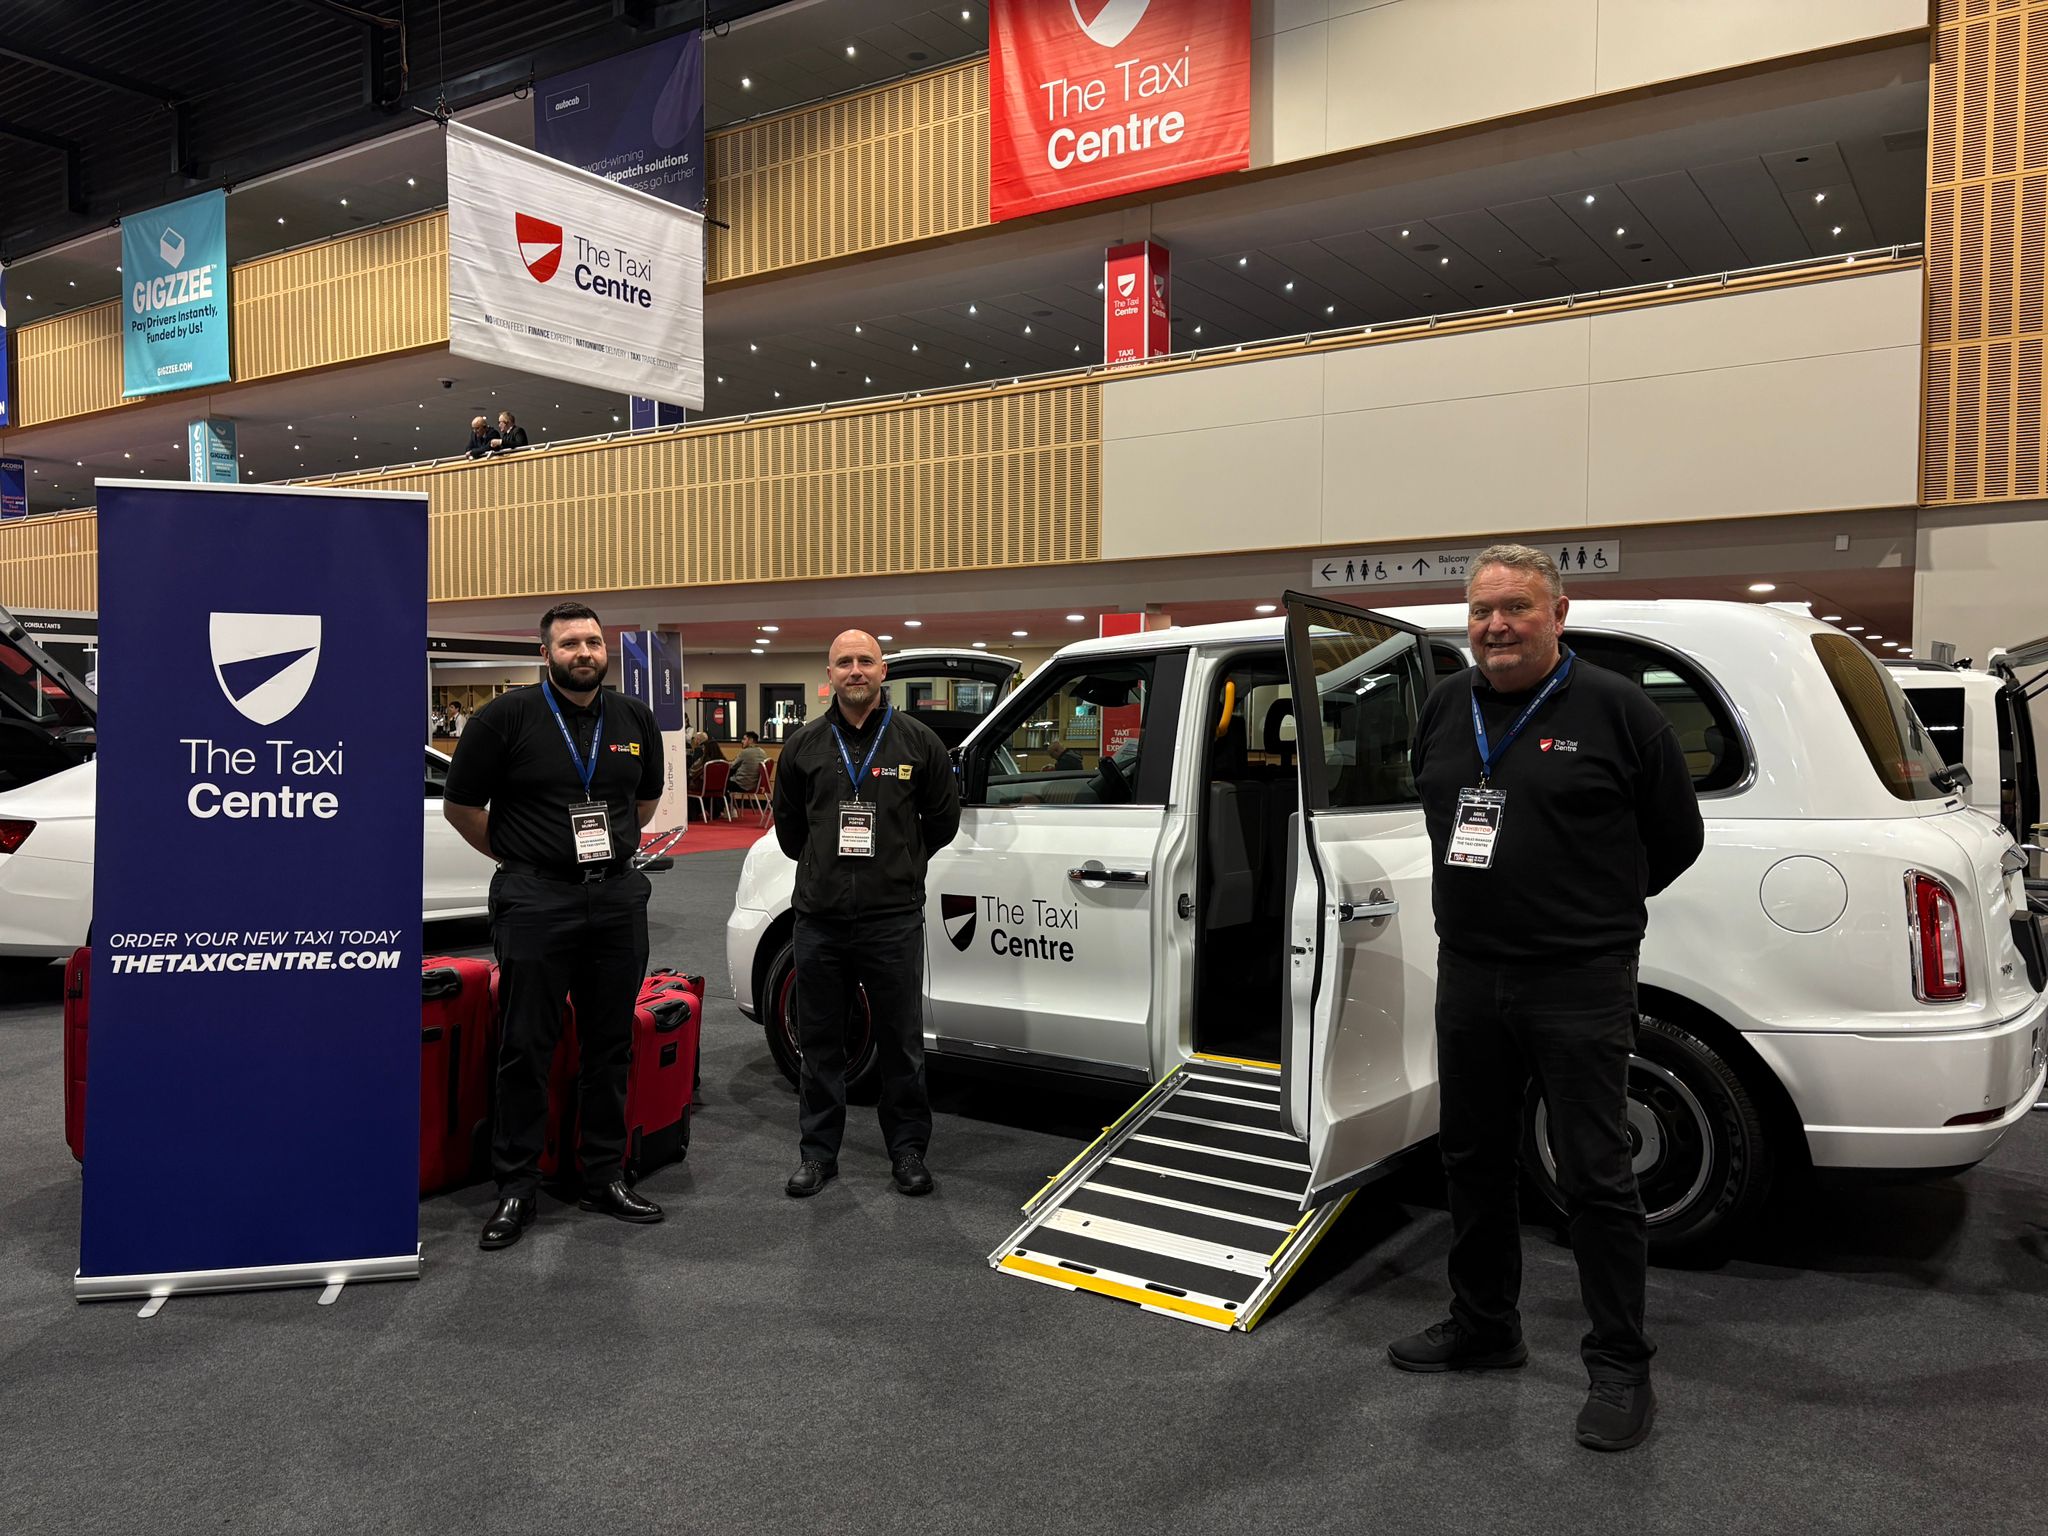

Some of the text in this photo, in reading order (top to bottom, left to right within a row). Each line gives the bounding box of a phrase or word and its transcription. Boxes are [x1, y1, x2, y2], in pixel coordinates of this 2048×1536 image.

[1039, 45, 1190, 121] The Taxi
[555, 95, 581, 111] autocab
[1047, 111, 1185, 170] Centre
[644, 153, 689, 174] solutions
[650, 175, 663, 190] go
[664, 167, 696, 184] further
[574, 235, 651, 282] The Taxi
[575, 264, 652, 308] Centre
[1114, 297, 1139, 308] The Taxi
[1114, 307, 1139, 317] Centre
[132, 304, 218, 332] Pay Drivers Instantly,
[146, 321, 203, 344] Funded by Us!
[485, 314, 493, 324] NO
[511, 321, 524, 333] FEES
[528, 325, 550, 339] FINANCE
[551, 331, 573, 344] EXPERTS
[575, 338, 605, 352] NATIONWIDE
[605, 345, 627, 358] DELIVERY
[630, 351, 640, 361] TAXI
[1118, 348, 1133, 357] TAXI
[157, 361, 193, 376] GIGZZEE.COM
[1, 462, 23, 470] ACORN
[1438, 555, 1470, 564] Balcony
[1450, 566, 1457, 575] &
[1459, 565, 1465, 574] 2
[24, 622, 61, 630] CONSULTANTS
[179, 738, 343, 775] The Taxi
[187, 782, 339, 819] Centre
[1462, 825, 1491, 833] EXHIBITOR
[981, 895, 1078, 930] The Taxi
[109, 930, 401, 948] ORDER YOUR NEW TAXI TODAY
[990, 928, 1074, 962] Centre
[110, 950, 401, 974] THETAXICENTRE.COM
